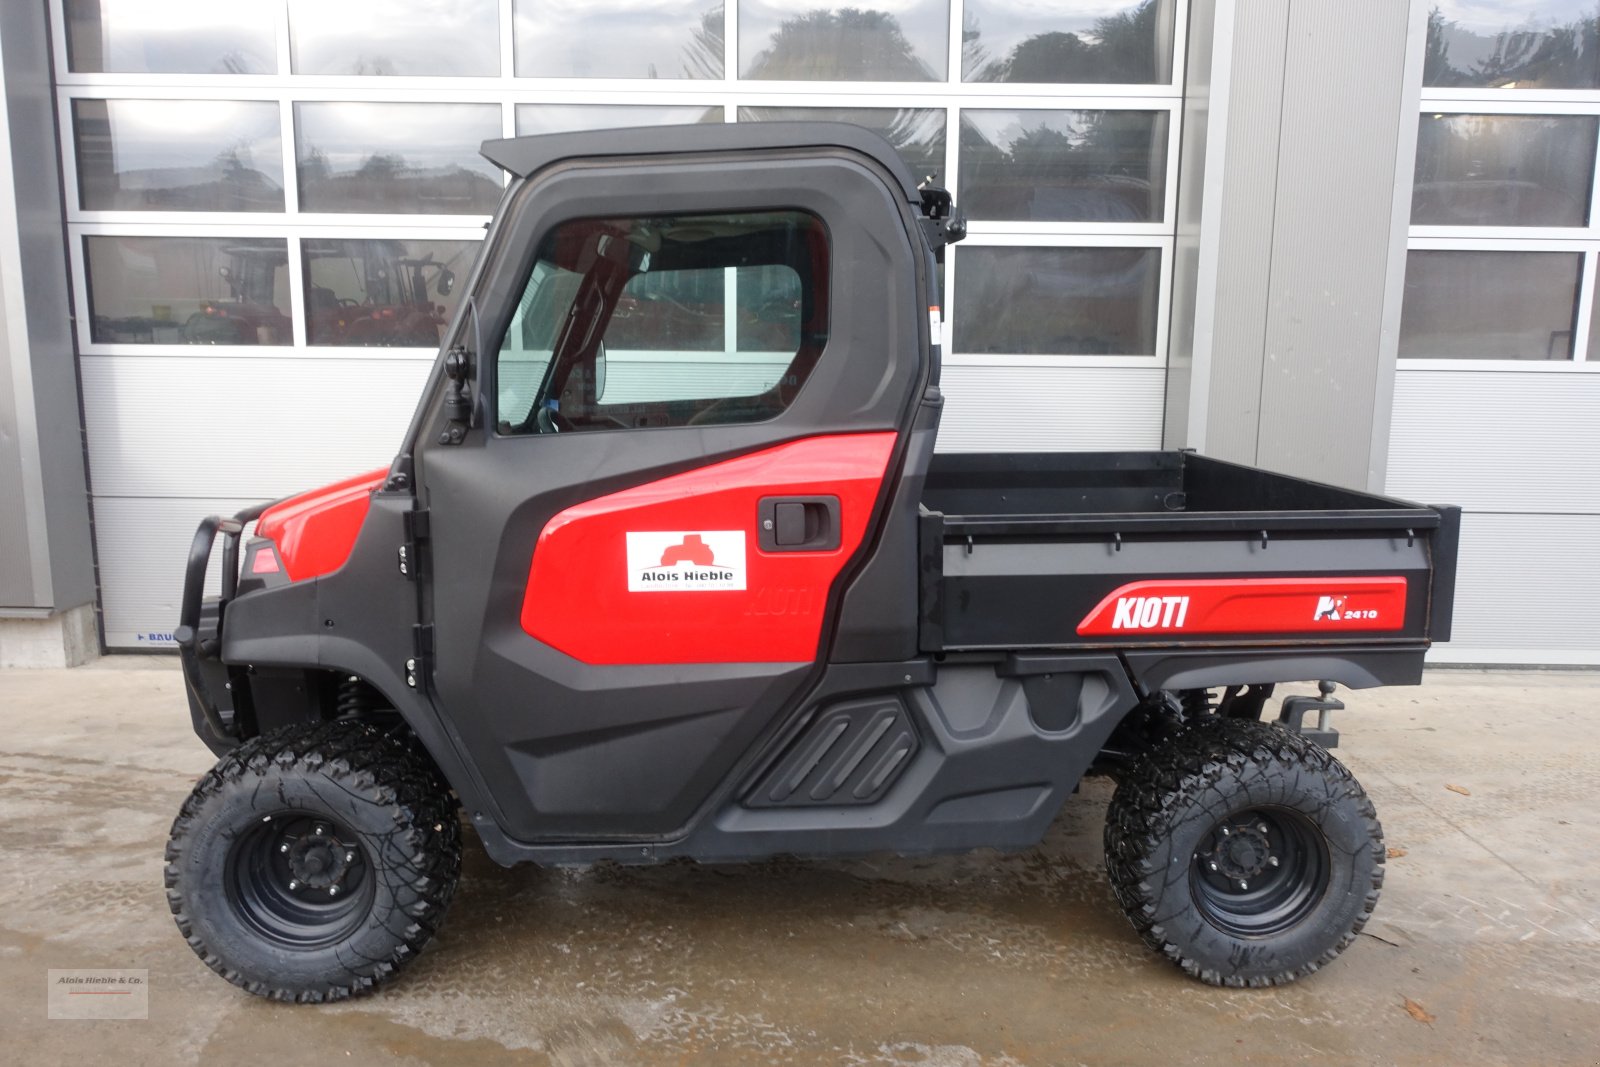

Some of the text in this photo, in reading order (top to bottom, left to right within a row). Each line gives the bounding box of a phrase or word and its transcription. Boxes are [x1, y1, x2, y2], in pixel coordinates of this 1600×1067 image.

[641, 570, 734, 582] Alois Hieble
[1112, 596, 1190, 629] KIOTI
[1343, 609, 1378, 620] 2410
[148, 632, 176, 641] BAU
